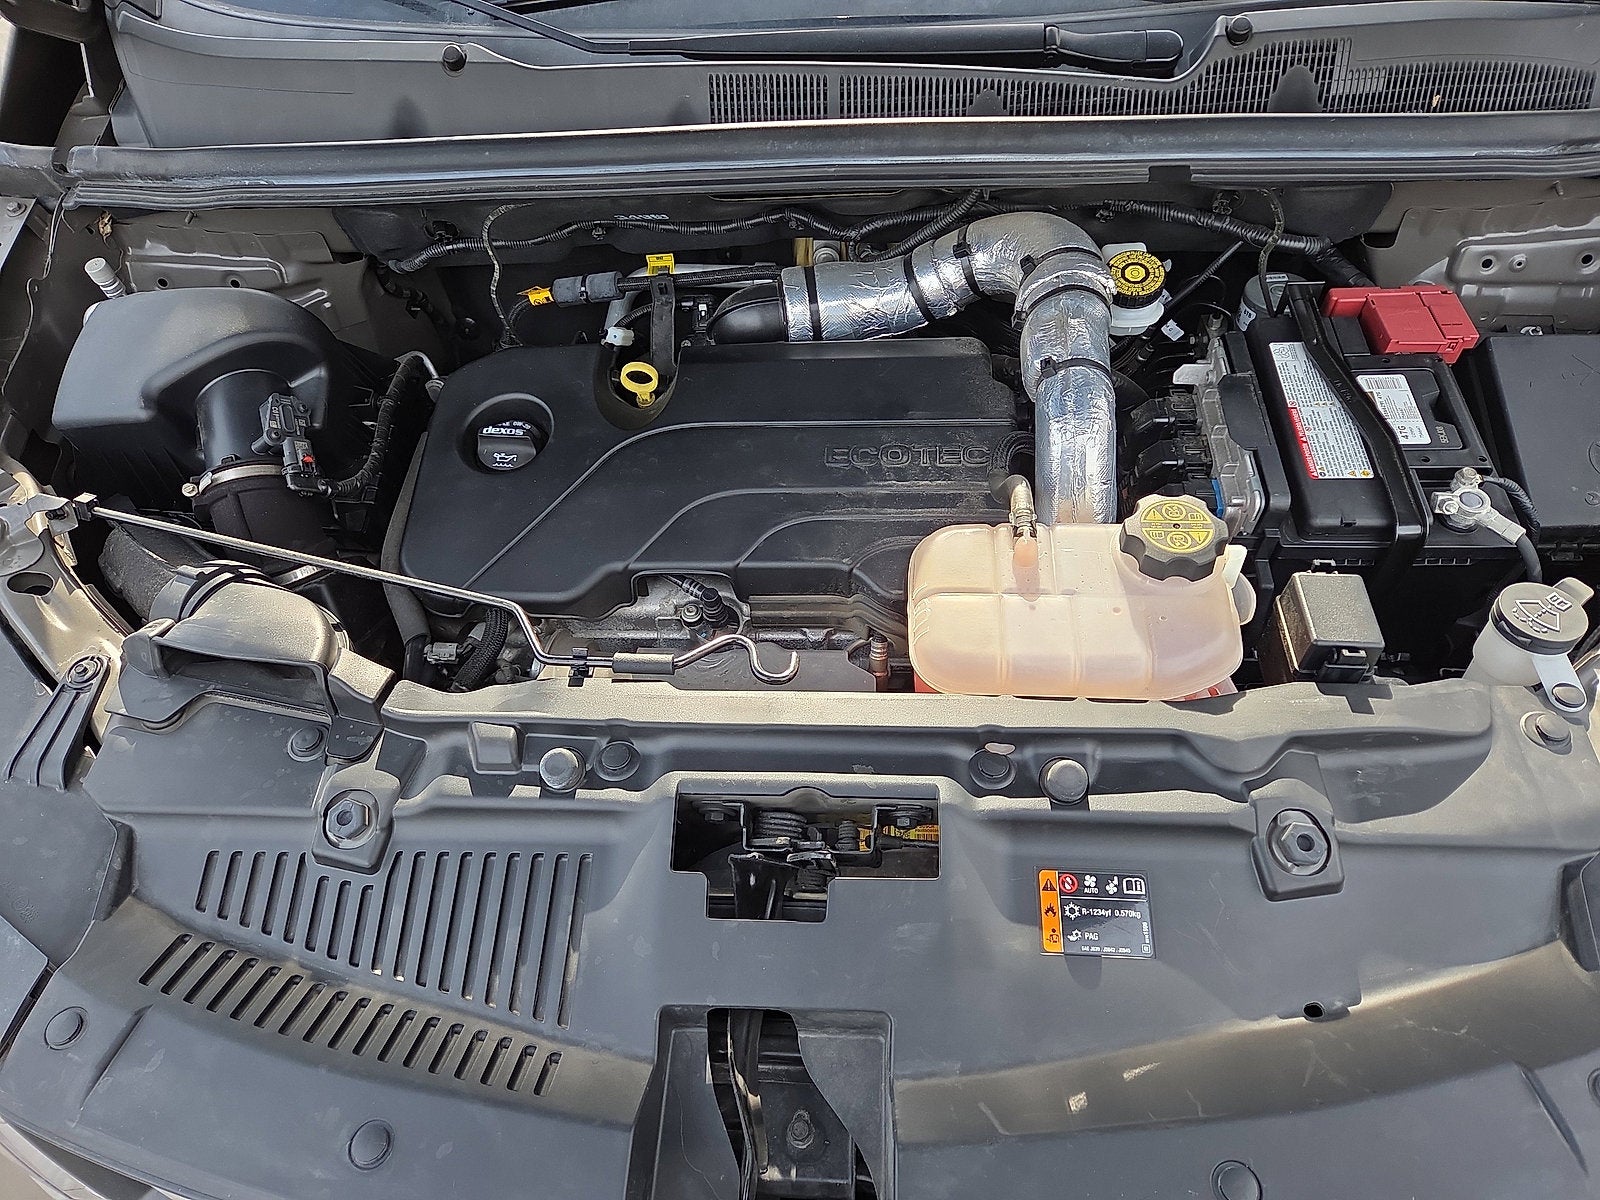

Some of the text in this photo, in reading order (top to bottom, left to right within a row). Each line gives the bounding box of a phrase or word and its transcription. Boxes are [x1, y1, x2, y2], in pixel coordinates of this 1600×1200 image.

[482, 426, 524, 435] dexos
[1397, 425, 1409, 440] 47G
[824, 443, 990, 468] ECOTEC
[1081, 907, 1141, 920] R-1234yf 0.570kg
[1084, 932, 1099, 941] PAG
